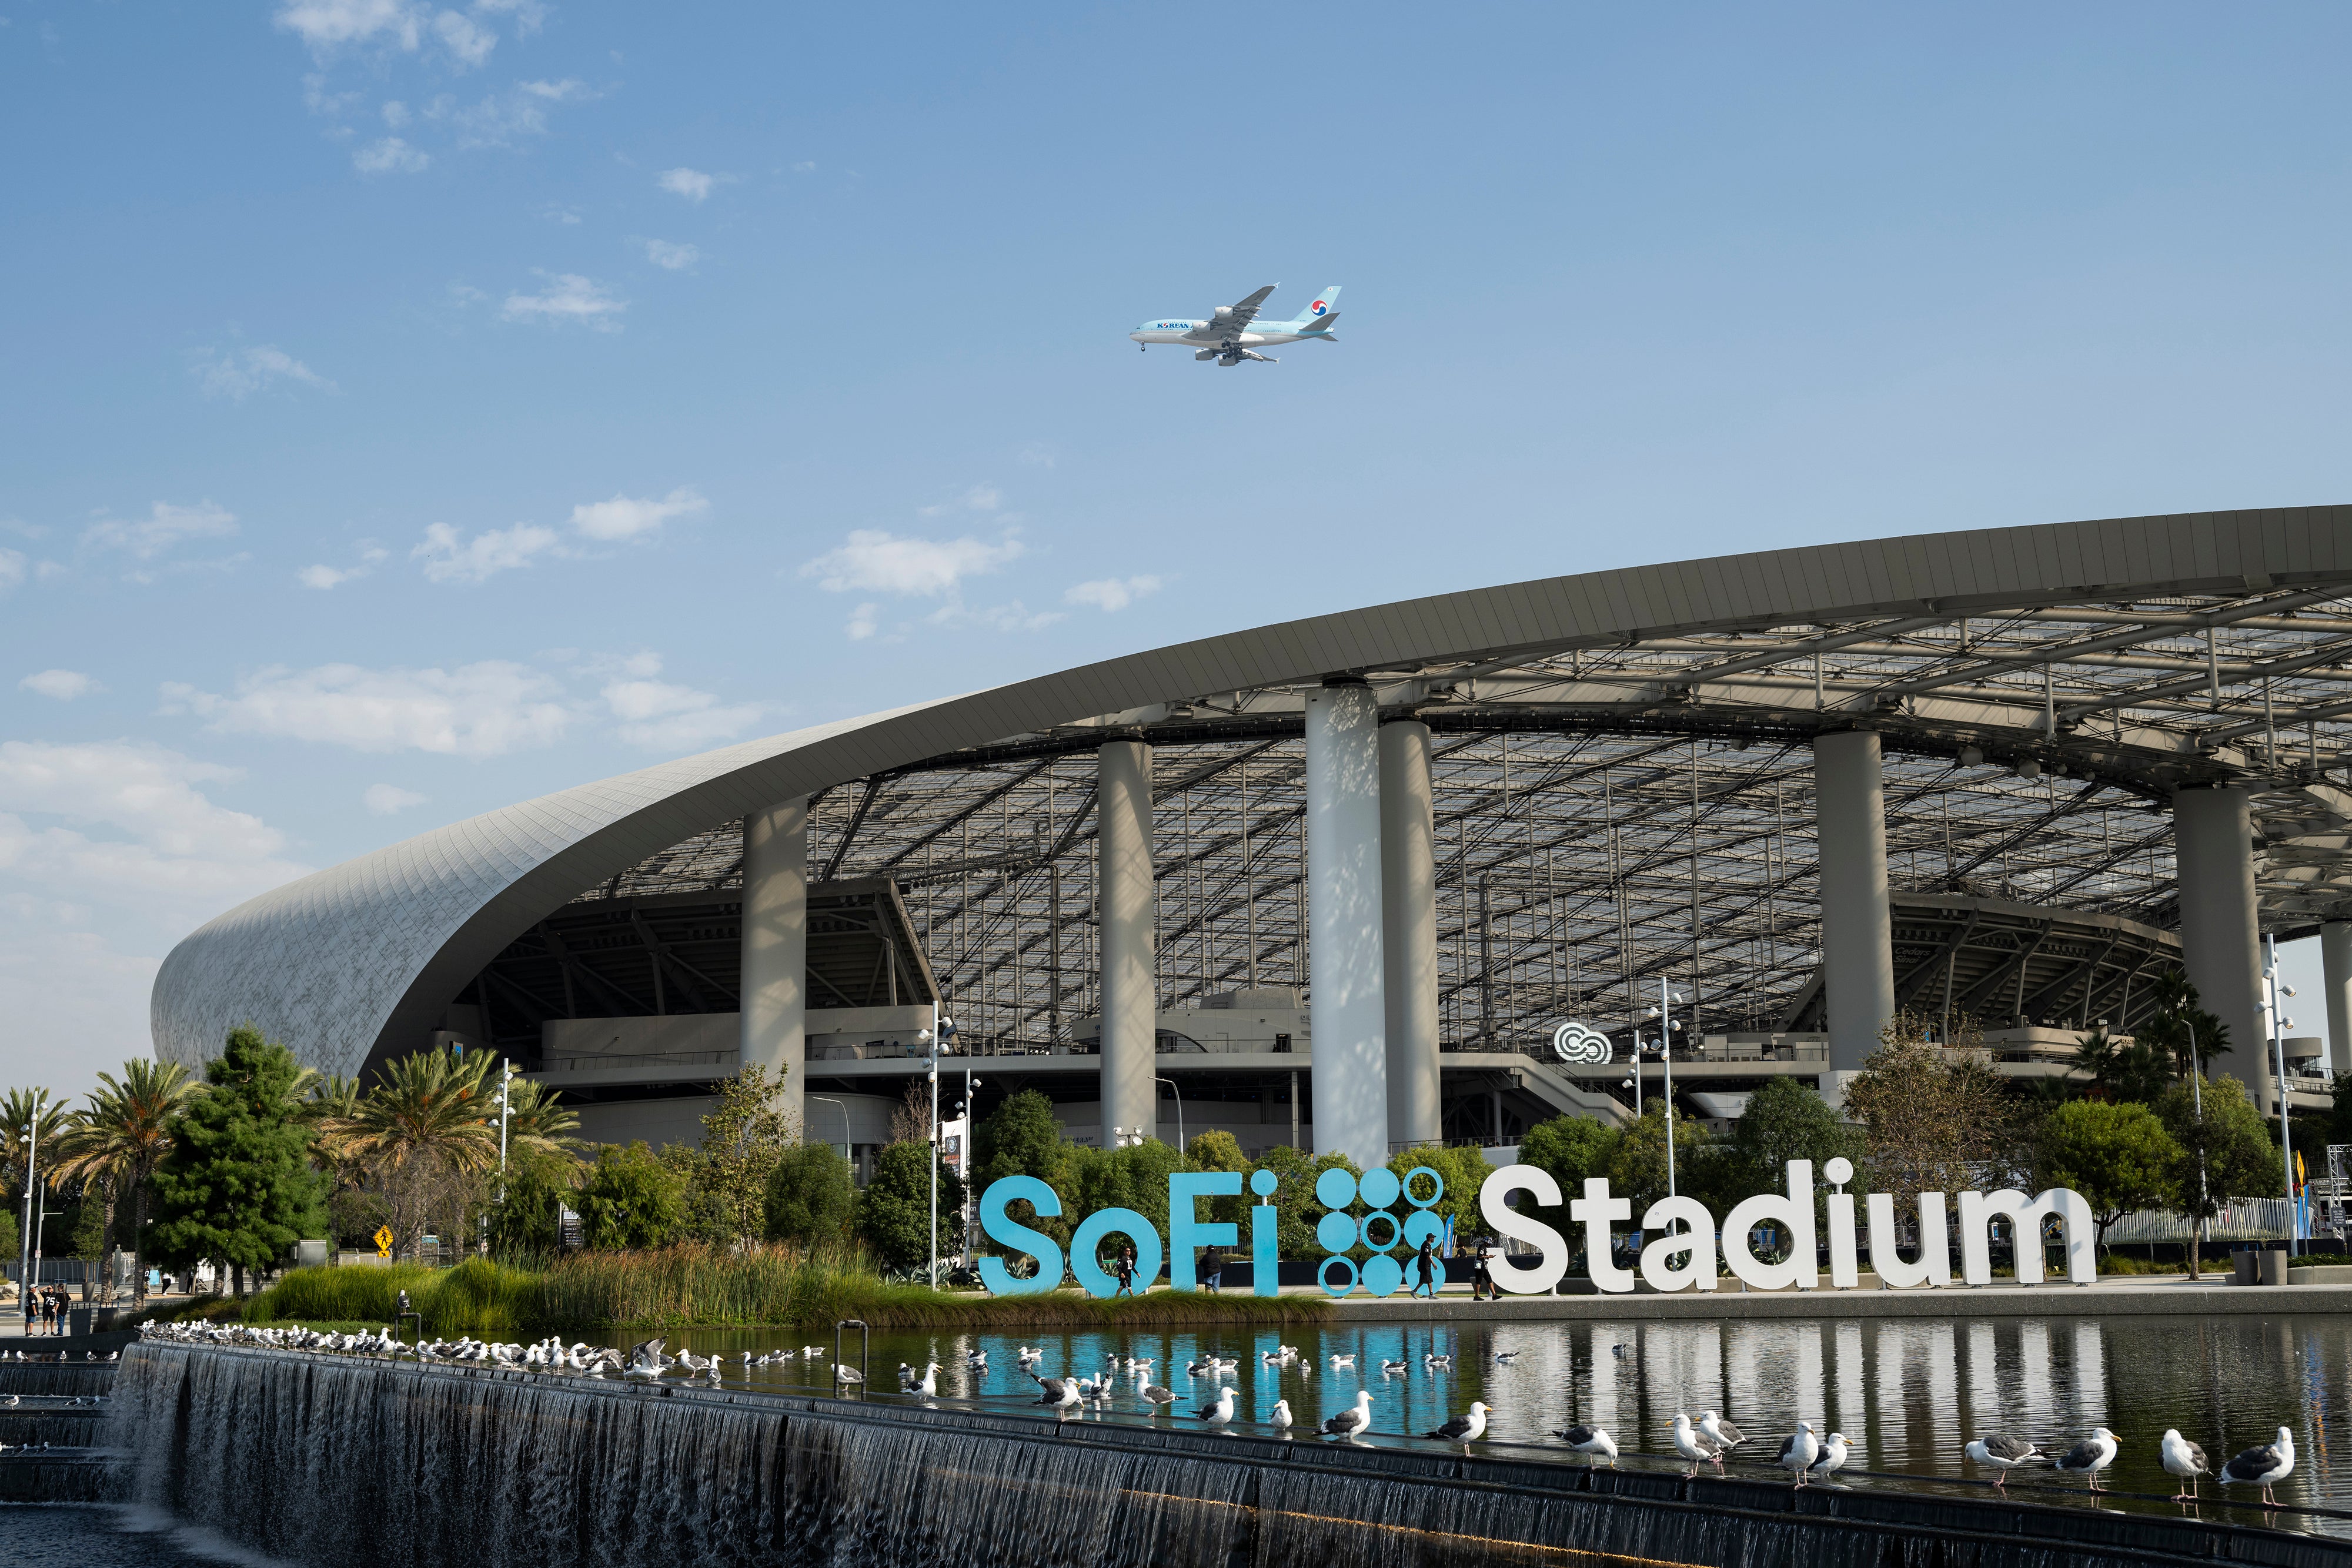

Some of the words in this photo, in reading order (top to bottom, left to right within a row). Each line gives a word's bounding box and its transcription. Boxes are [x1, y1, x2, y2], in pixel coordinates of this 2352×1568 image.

[1895, 947, 1931, 956] Cedars
[1893, 955, 1921, 964] Sinai
[980, 1169, 1279, 1298] SoFi
[1479, 1156, 2096, 1294] Stadium
[46, 1296, 56, 1306] 75
